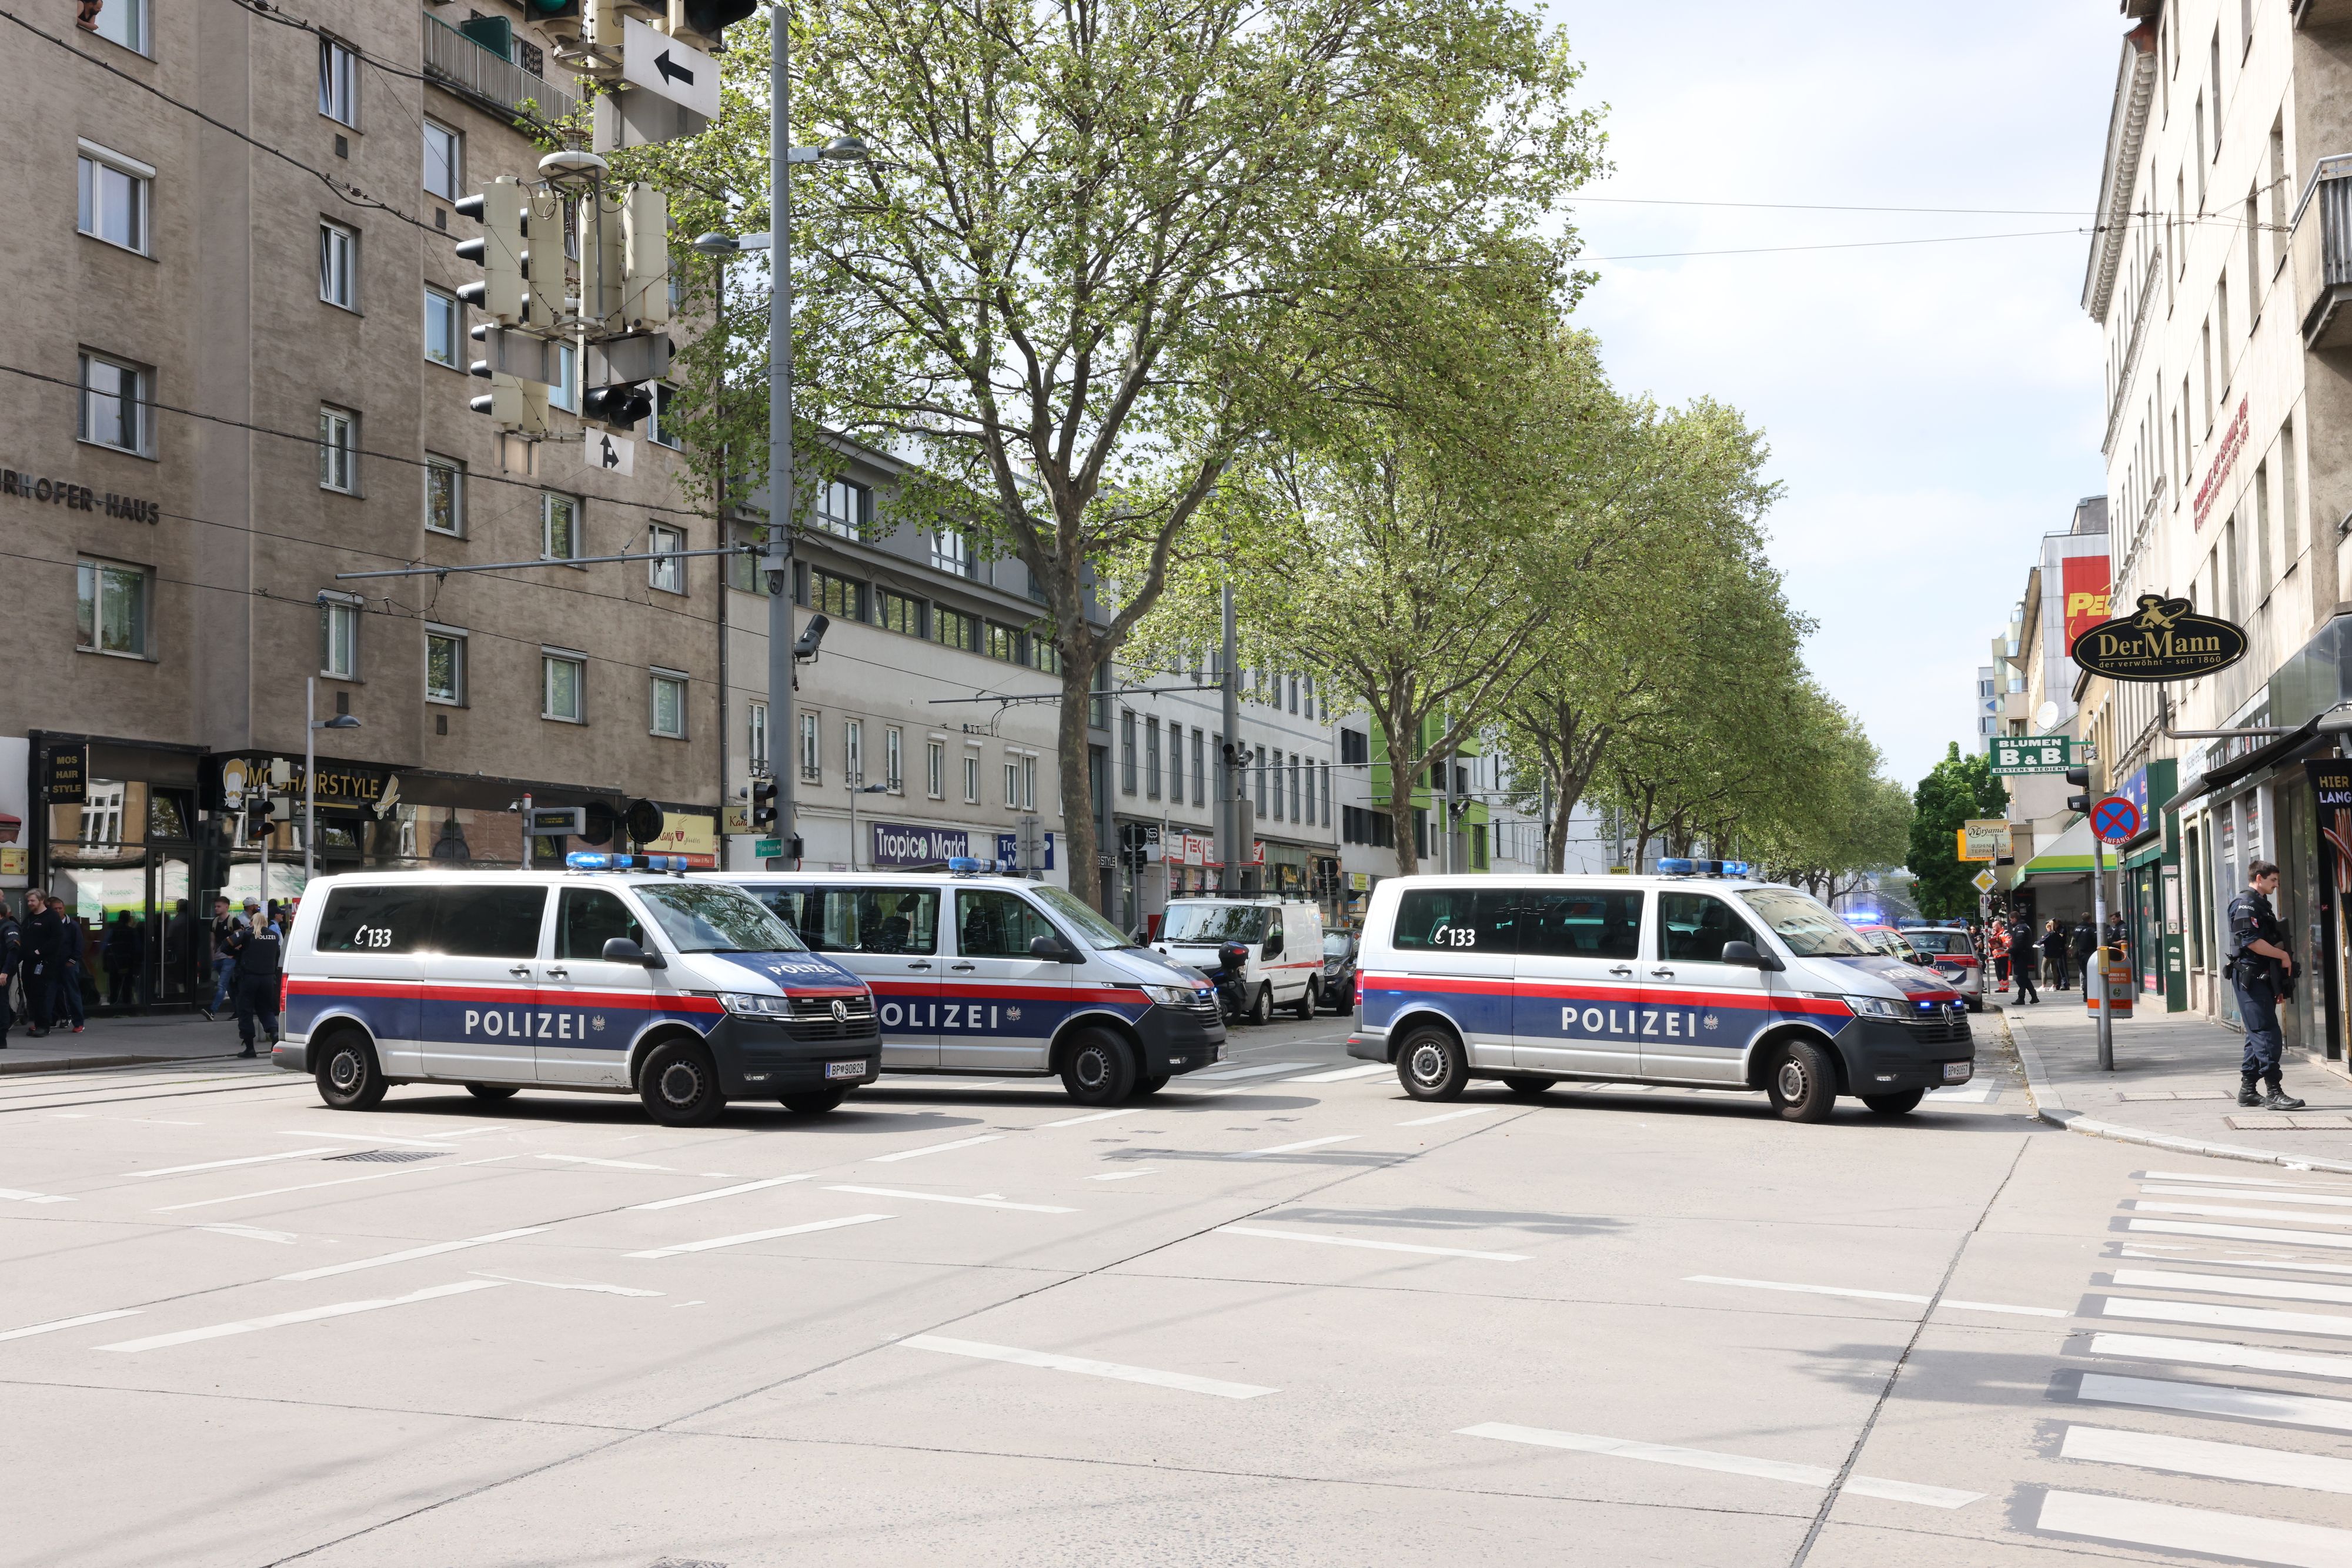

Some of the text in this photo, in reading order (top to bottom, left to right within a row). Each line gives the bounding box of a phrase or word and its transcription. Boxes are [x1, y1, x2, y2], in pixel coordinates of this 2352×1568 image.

[0, 469, 160, 525] RHOFER-HAUS
[2119, 659, 2163, 667] verwöhnt
[1999, 738, 2062, 748] BLUMEN
[56, 756, 78, 764] MOS
[2000, 749, 2020, 765] B
[2024, 755, 2037, 765] &
[56, 770, 78, 779] HAIR
[2319, 776, 2349, 787] HIER
[52, 784, 81, 793] STYLE
[2319, 791, 2352, 803] LANG
[729, 816, 747, 832] Kan
[2103, 834, 2130, 844] ANFANG
[877, 828, 966, 863] Tropico Markt
[1101, 855, 1115, 865] STYLE
[368, 928, 392, 947] 133
[1448, 928, 1475, 947] 133
[767, 965, 843, 975] POLIZEI
[880, 1002, 997, 1028] OLIZEI
[465, 1009, 585, 1040] POLIZEI
[1562, 1007, 1695, 1037] POLIZEI
[832, 1063, 864, 1075] BP 90829
